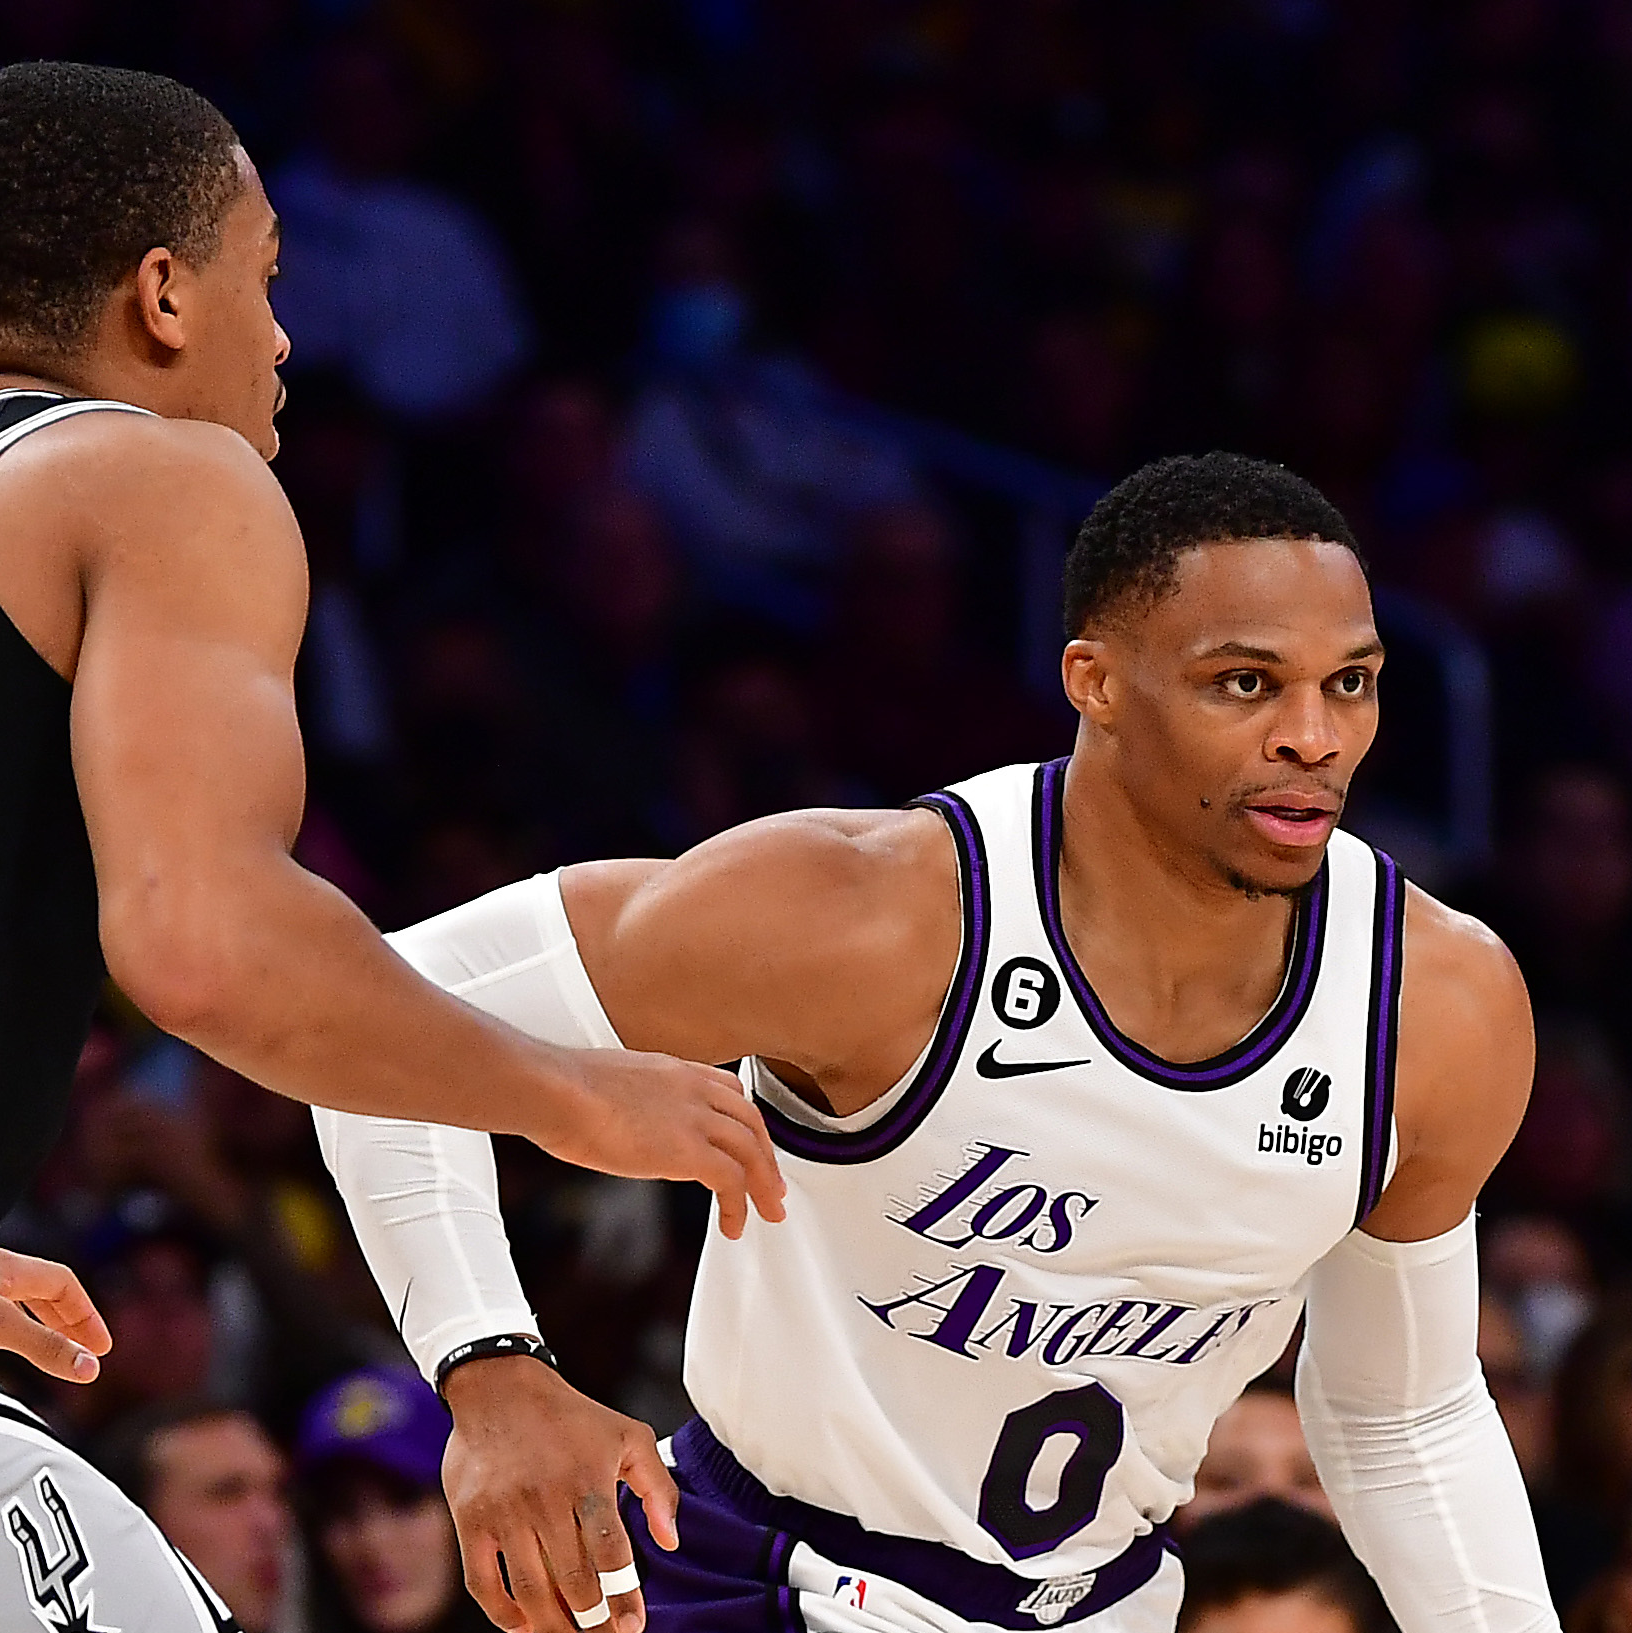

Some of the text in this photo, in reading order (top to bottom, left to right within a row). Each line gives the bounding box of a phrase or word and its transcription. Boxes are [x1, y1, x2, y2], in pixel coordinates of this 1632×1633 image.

[1004, 966, 1045, 1022] 6
[1258, 1123, 1343, 1166] bibigo
[977, 1381, 1125, 1562] 0
